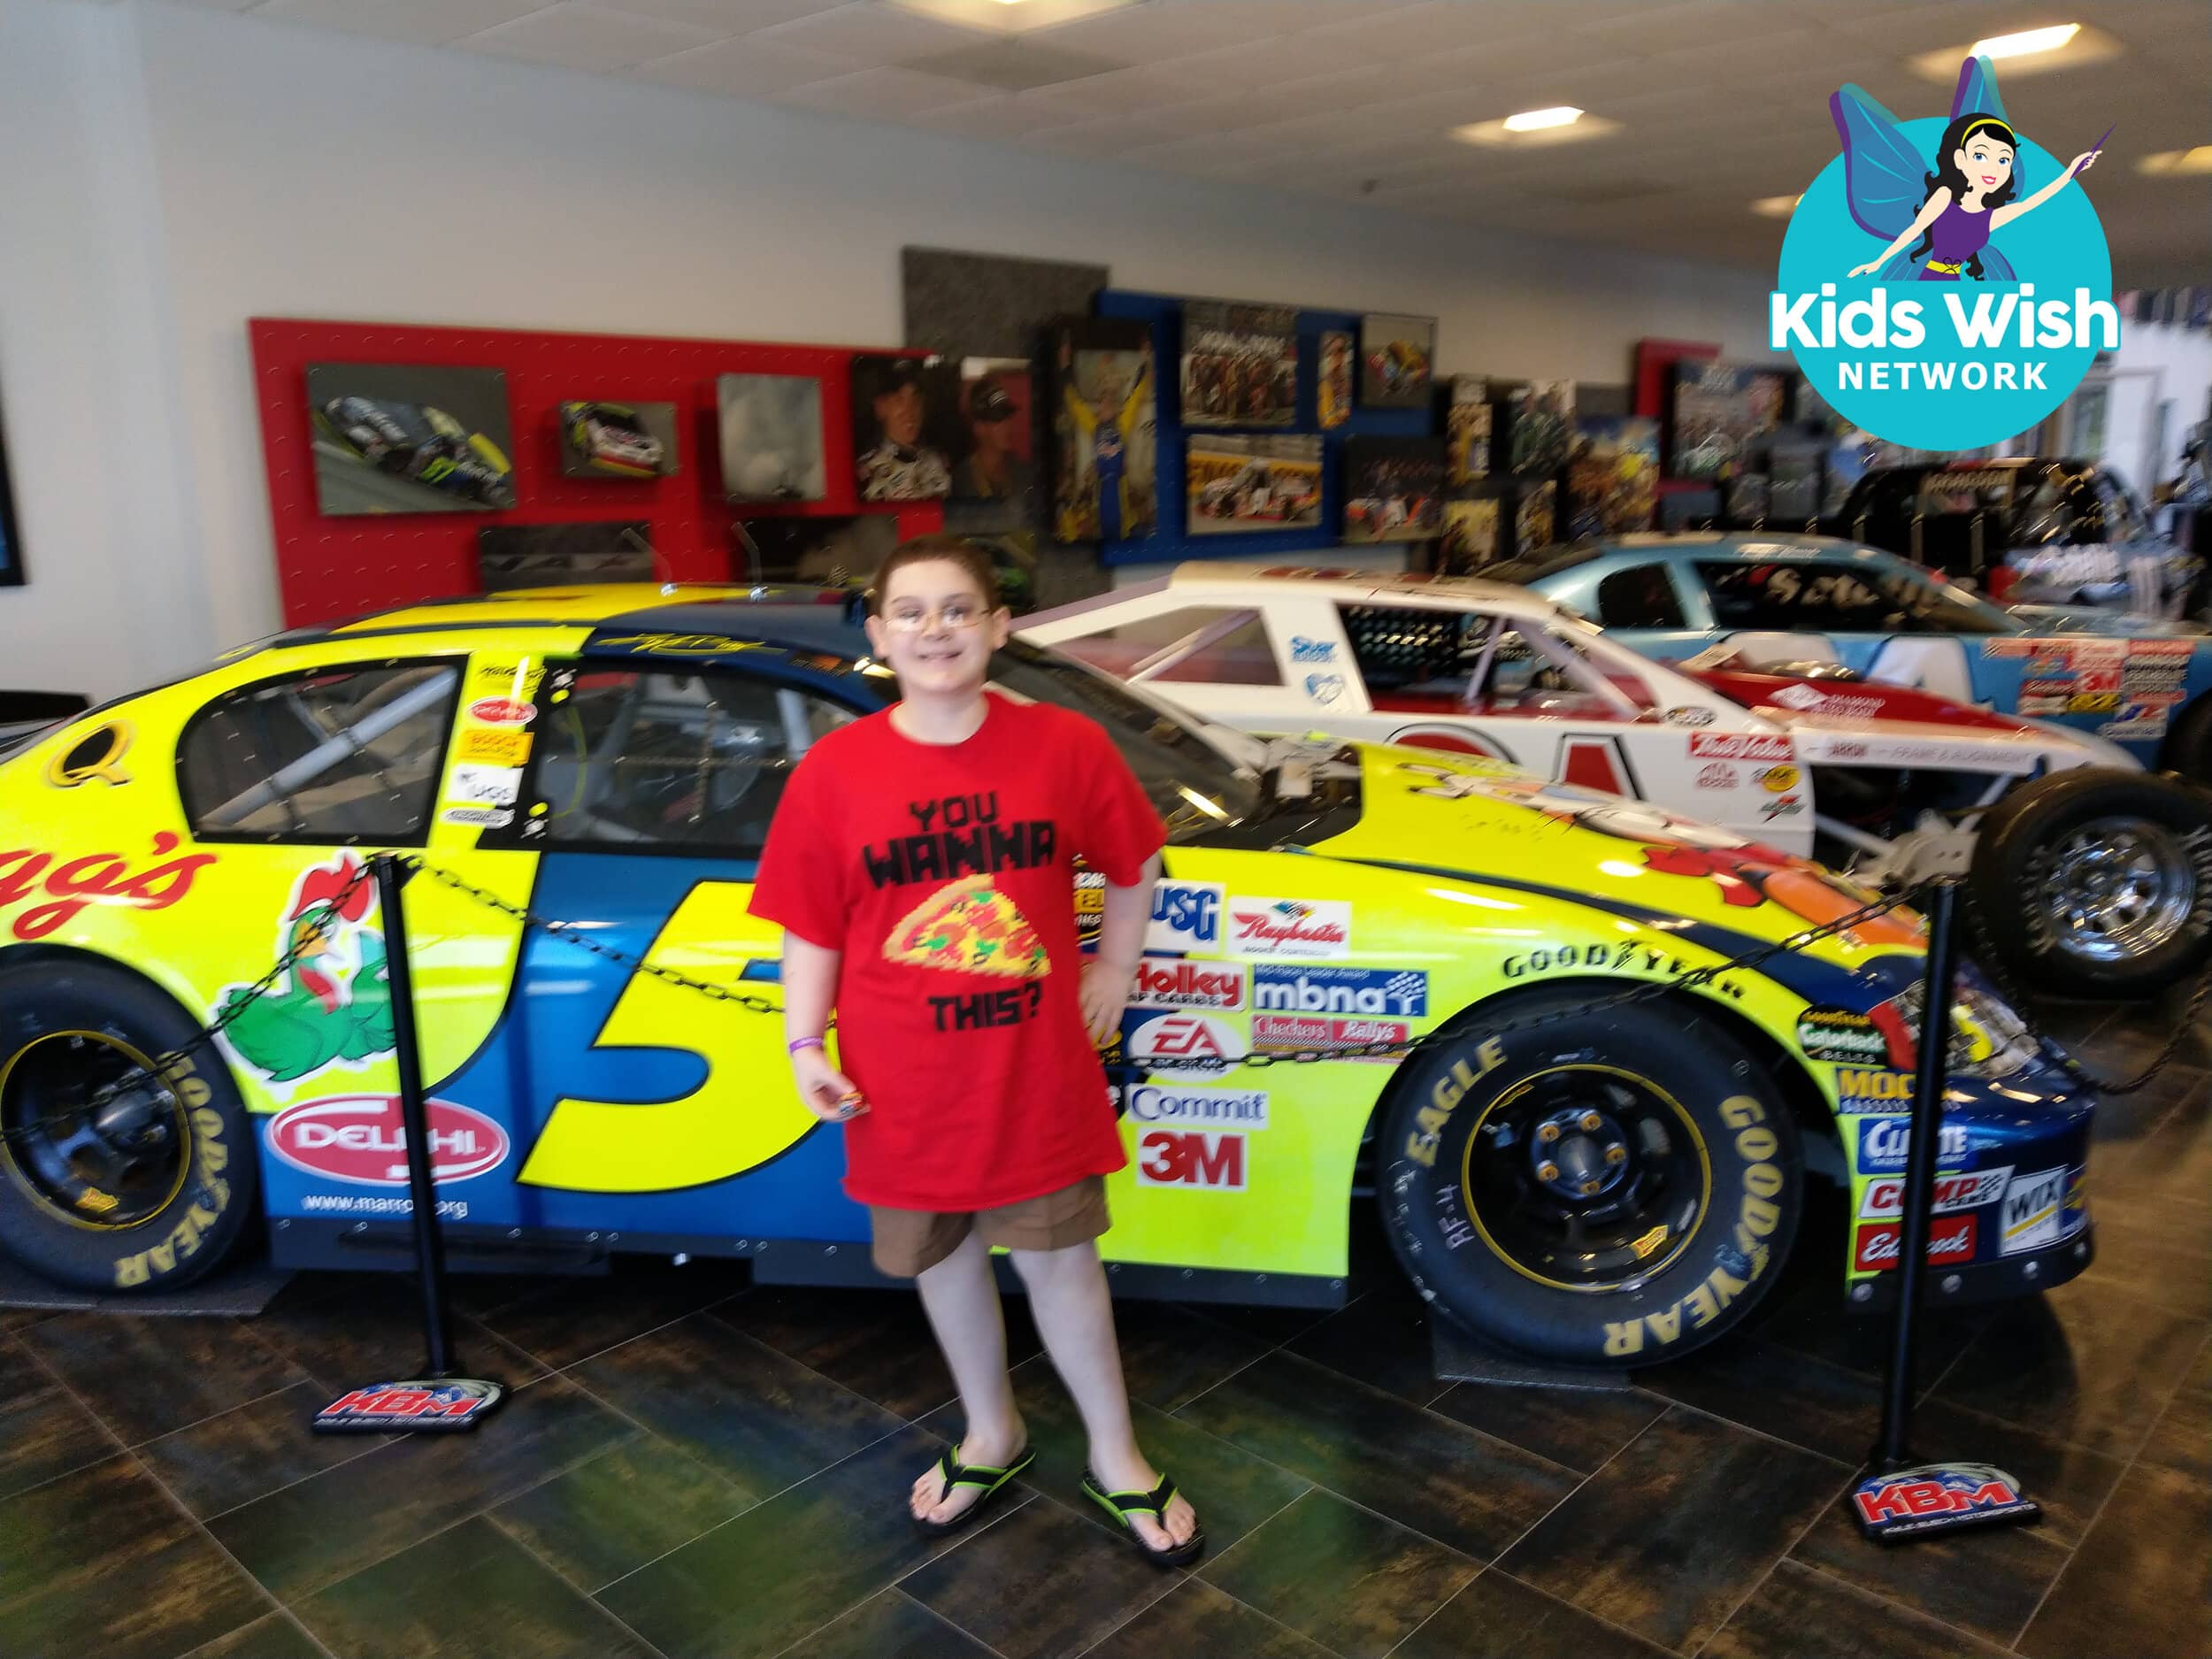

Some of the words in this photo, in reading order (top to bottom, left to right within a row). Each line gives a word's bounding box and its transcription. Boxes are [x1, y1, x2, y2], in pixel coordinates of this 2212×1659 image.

[909, 791, 998, 831] YOU
[863, 819, 1056, 890] WANNA
[927, 981, 1042, 1032] THIS?
[1254, 975, 1387, 1015] mbna
[1152, 1018, 1225, 1057] EA
[1255, 1017, 1326, 1040] Checkers
[1132, 1087, 1268, 1121] Commit
[1405, 1035, 1508, 1168] EAGLE
[1141, 1130, 1246, 1187] 3M
[303, 1194, 469, 1220] www.marroorg
[1602, 1094, 1784, 1357] GOODYEAR
[317, 1387, 487, 1417] KBM
[1853, 1480, 2018, 1525] KBM
